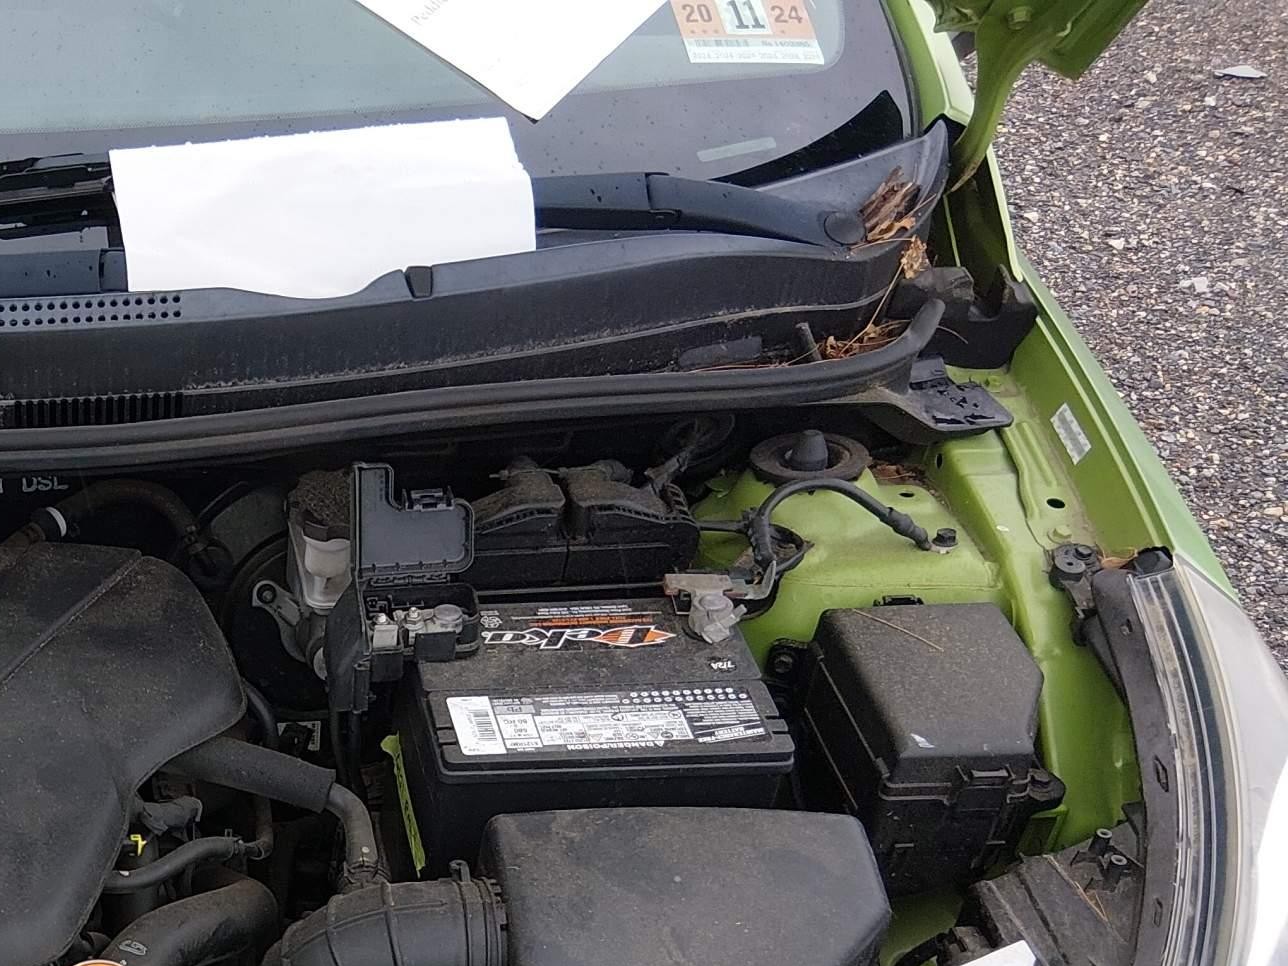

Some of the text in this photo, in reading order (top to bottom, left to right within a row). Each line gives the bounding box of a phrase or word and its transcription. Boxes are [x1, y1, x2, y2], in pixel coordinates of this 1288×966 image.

[682, 0, 803, 29] 20 11 24
[484, 625, 677, 649] Deka
